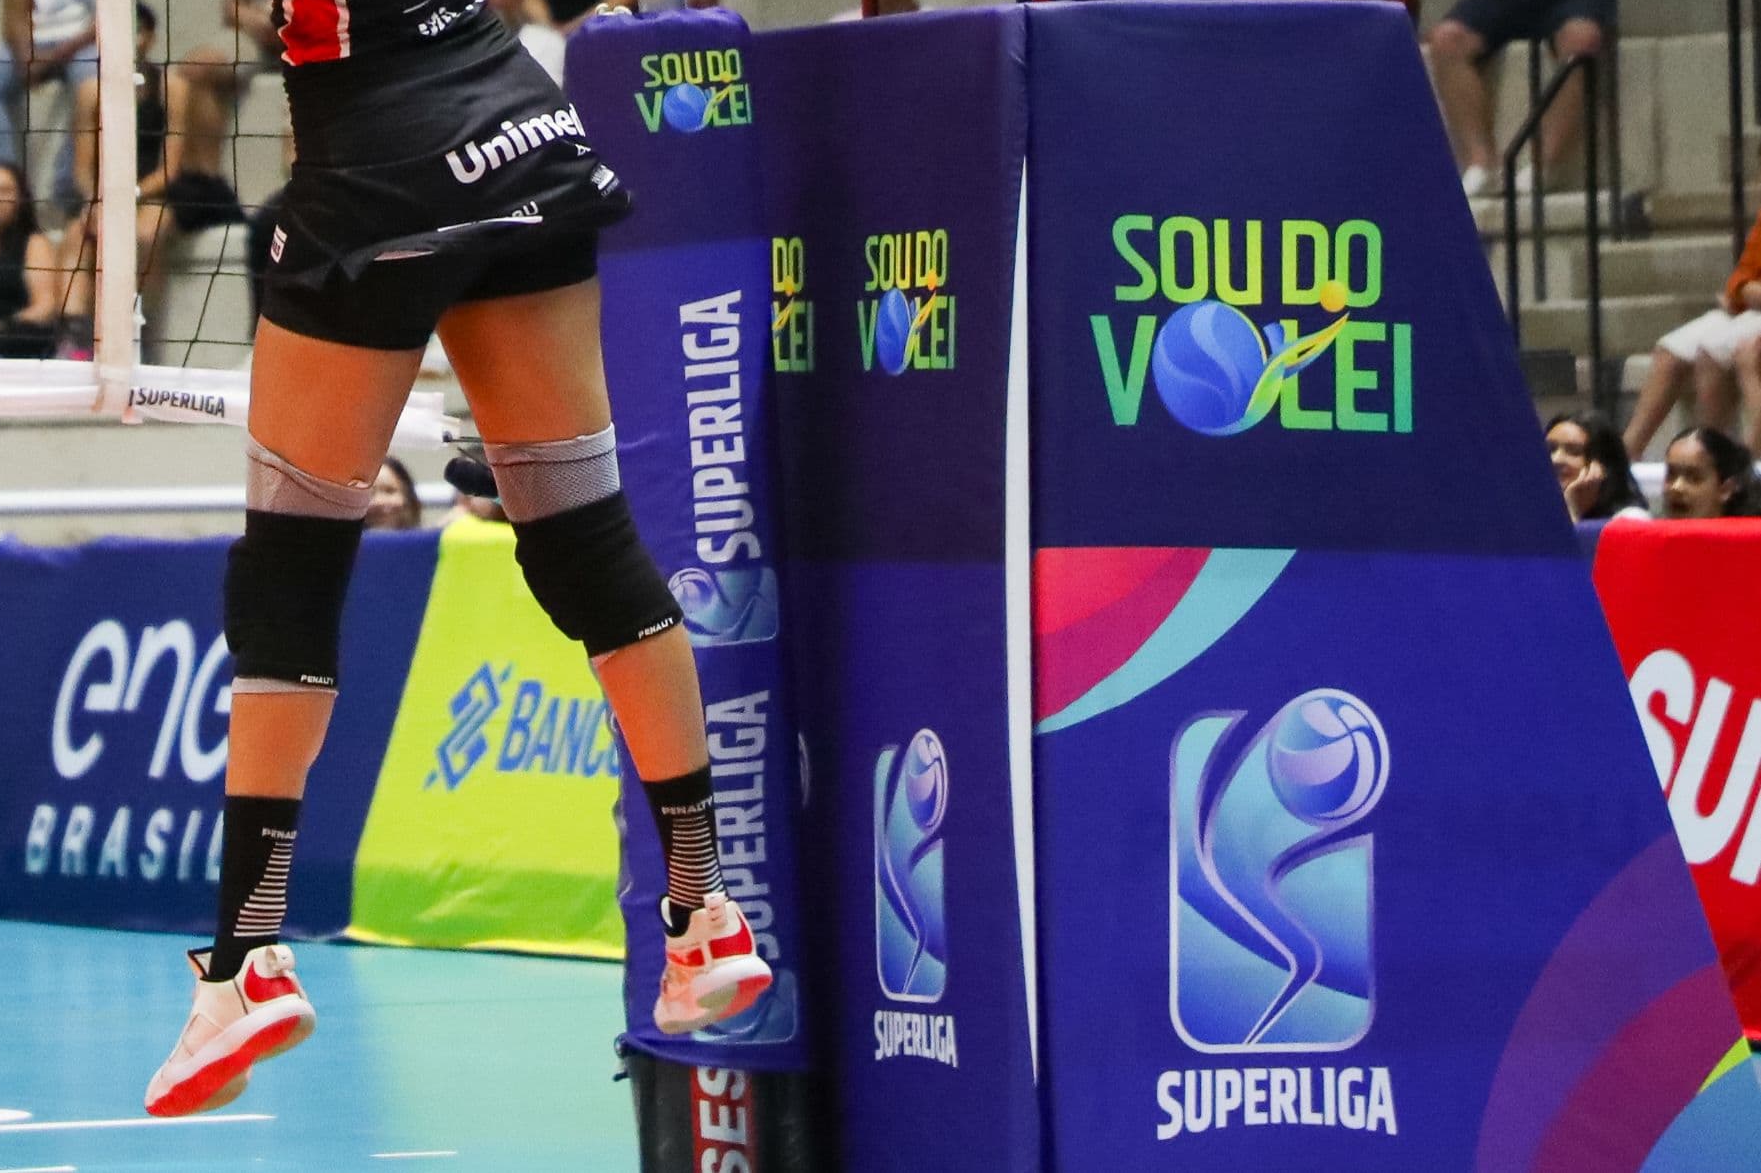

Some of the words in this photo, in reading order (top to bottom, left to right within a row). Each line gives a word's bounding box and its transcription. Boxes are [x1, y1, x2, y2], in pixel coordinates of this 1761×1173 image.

[641, 50, 704, 88] SOU
[707, 48, 742, 83] DO
[864, 231, 912, 293] SOU
[915, 228, 949, 289] DO
[1111, 213, 1263, 305] SOU
[1281, 218, 1383, 309] DO
[136, 387, 227, 418] SUPERLIGA
[678, 289, 763, 565] SUPERLIGA
[873, 1009, 959, 1069] SUPERLIGA
[1156, 1065, 1398, 1141] SUPERLIGA
